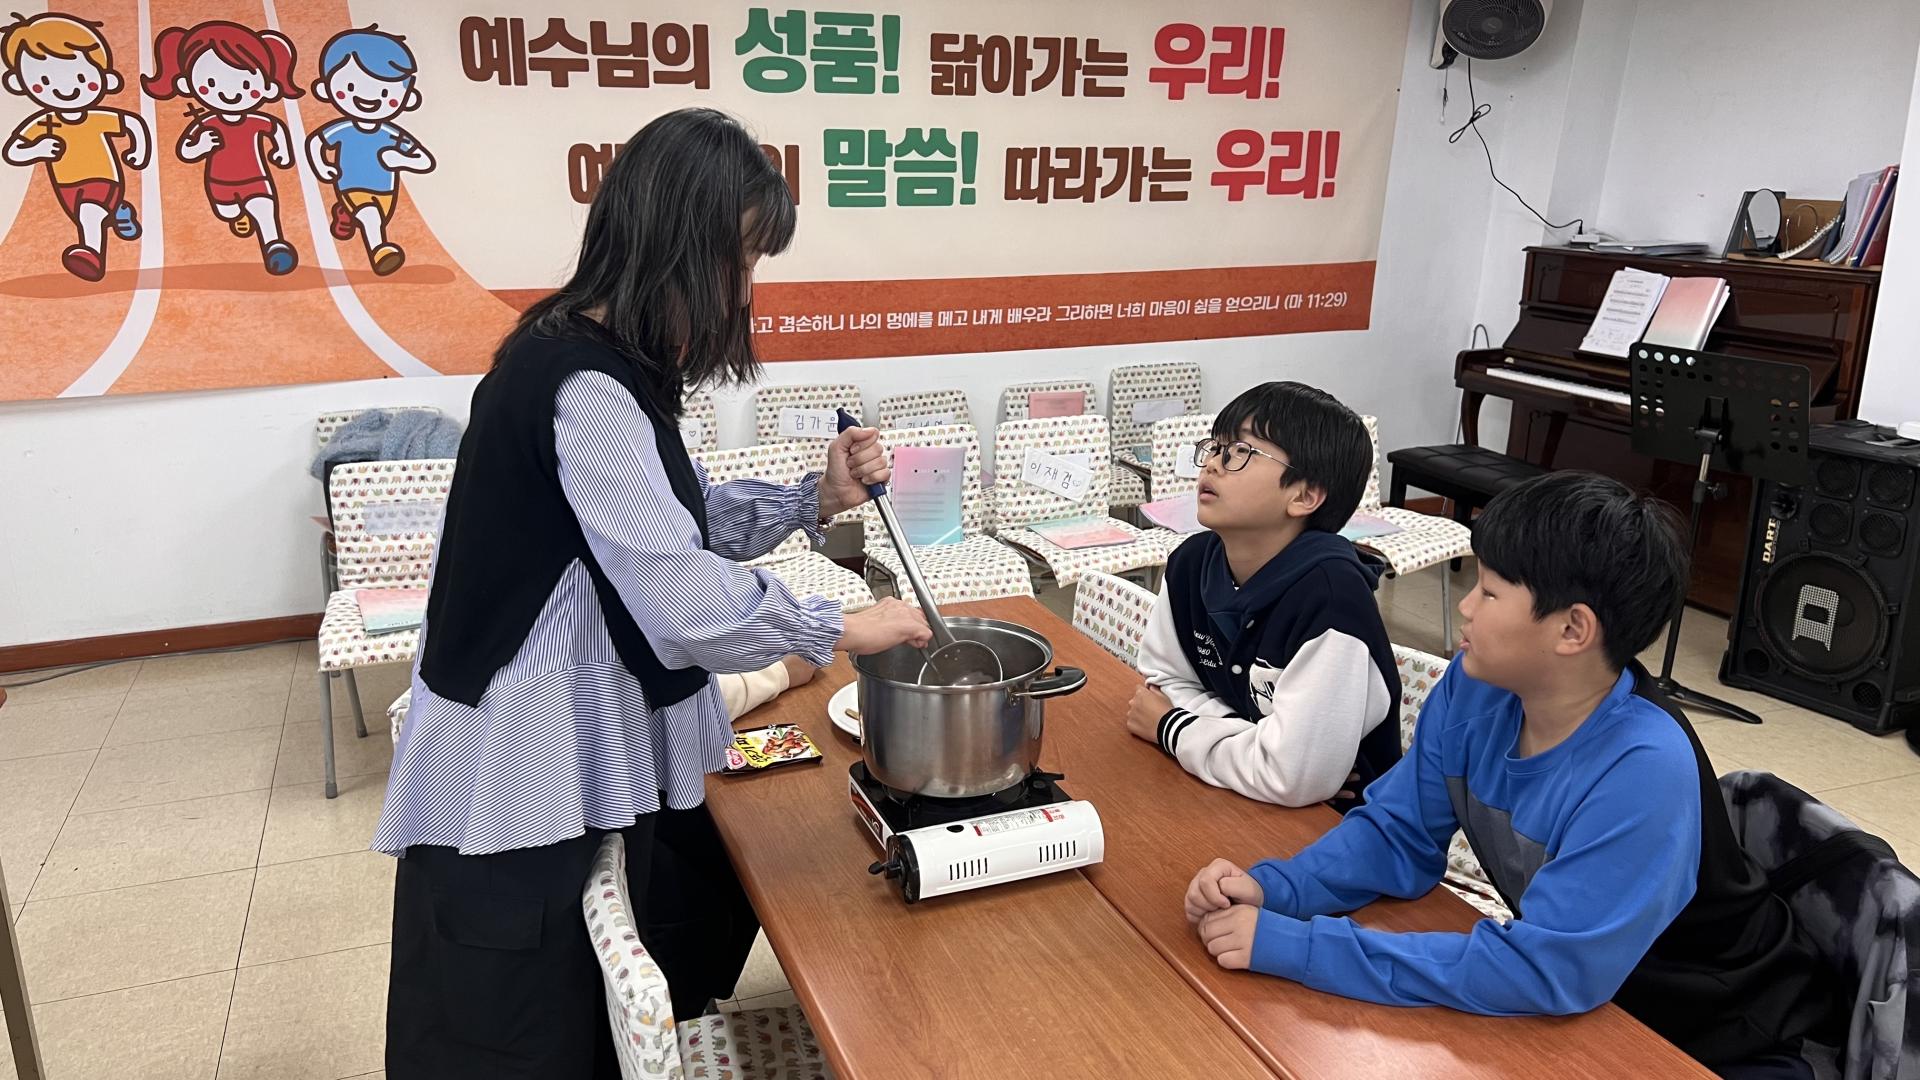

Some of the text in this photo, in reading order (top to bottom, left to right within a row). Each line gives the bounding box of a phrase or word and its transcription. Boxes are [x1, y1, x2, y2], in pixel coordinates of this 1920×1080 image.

[459, 7, 1286, 100] 예수님의 성품! 닮아가는 우리!
[823, 127, 979, 208] 말씀!
[1004, 146, 1192, 204] 따라가는
[1210, 129, 1341, 202] 우리!
[778, 314, 844, 333] 겸손하니
[850, 312, 880, 331] 나의
[886, 311, 933, 329] 멍에를
[938, 310, 968, 328] 메고
[972, 308, 1002, 326] 내게
[1007, 306, 1052, 324] 배우라
[1055, 303, 1113, 322] 그리하면
[1117, 301, 1145, 319] 너희
[1149, 299, 1190, 317] 마음이
[1194, 297, 1222, 315] 쉼을
[1226, 294, 1280, 312] 얻으리니
[1284, 293, 1303, 311] (마
[1307, 291, 1347, 309] 11:29)
[1762, 518, 1776, 563] DART
